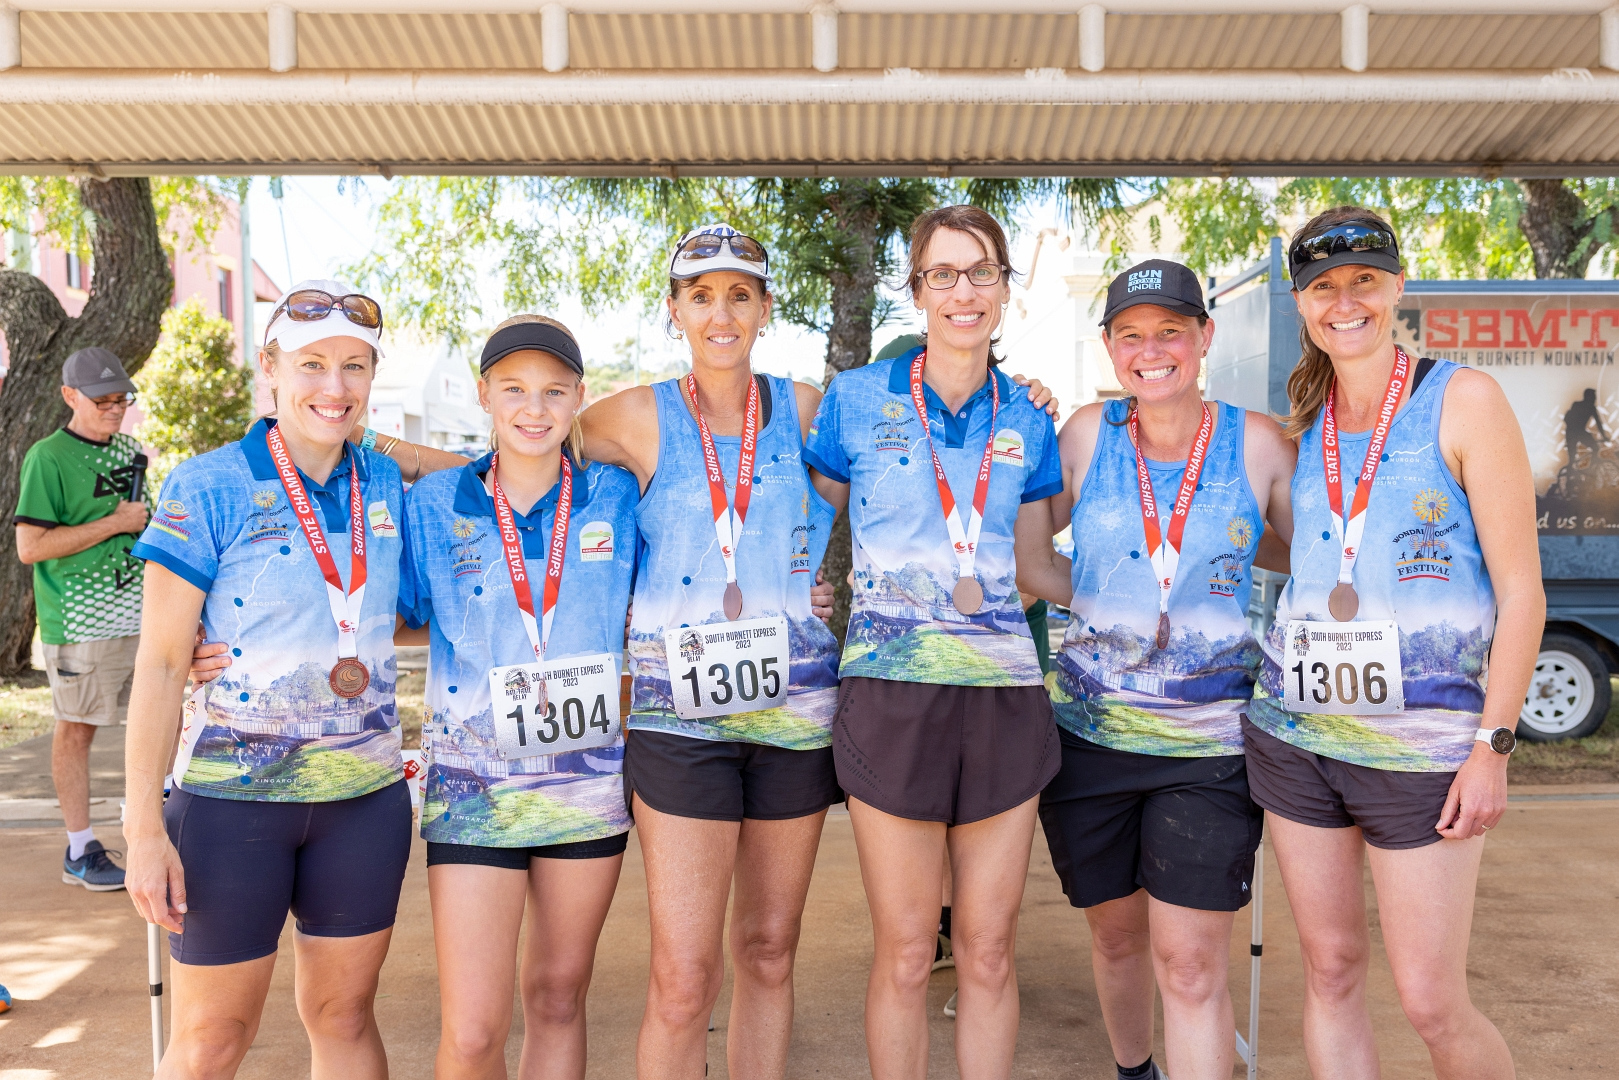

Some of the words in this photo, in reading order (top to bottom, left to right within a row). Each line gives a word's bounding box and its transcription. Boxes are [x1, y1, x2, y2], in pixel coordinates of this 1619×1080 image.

[1128, 269, 1163, 281] RUN
[1127, 283, 1162, 293] UNDER
[1477, 352, 1534, 366] BURNETT
[1543, 352, 1615, 366] MOUNTAIN
[1362, 379, 1403, 482] CHAMPIONSHIPS
[875, 441, 909, 450] FESTIVAL
[740, 452, 752, 486] STATE
[979, 446, 993, 482] STATE
[1326, 449, 1339, 484] STATE
[1175, 483, 1194, 517] STATE
[549, 475, 572, 578] CHAMPIONSHIPS
[1556, 515, 1577, 529] us
[302, 517, 327, 554] STATE
[1392, 529, 1425, 544] WONDAI
[1434, 520, 1461, 538] COUNTRY
[453, 563, 482, 574] FESTIVAL
[507, 545, 526, 582] STATE
[1397, 564, 1450, 577] FESTIVAL
[704, 633, 725, 645] SOUTH
[725, 629, 752, 642] BURNETT
[752, 626, 777, 639] EXPRESS
[735, 639, 752, 650] 2023
[1310, 631, 1327, 642] SOUTH
[1327, 632, 1354, 642] BURNETT
[1354, 630, 1383, 642] EXPRESS
[1335, 642, 1352, 651] 2023
[553, 667, 580, 680] BURNETT
[580, 664, 604, 676] EXPRESS
[562, 677, 578, 688] 2023
[681, 656, 780, 708] 1305
[1291, 660, 1388, 705] 1306
[506, 693, 610, 747] 1304
